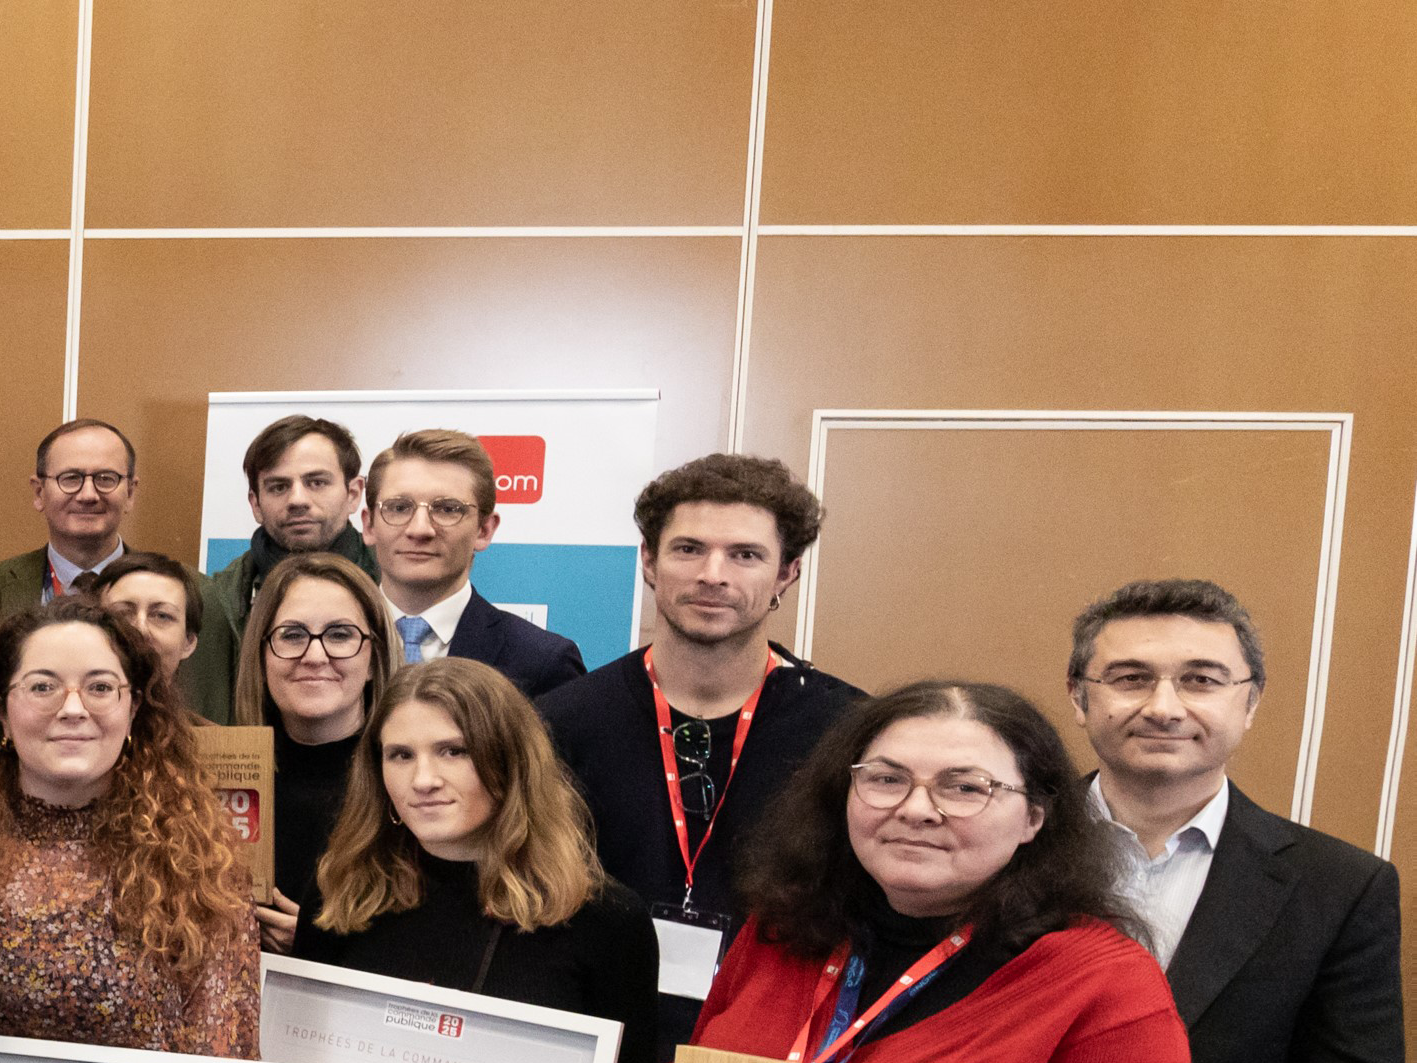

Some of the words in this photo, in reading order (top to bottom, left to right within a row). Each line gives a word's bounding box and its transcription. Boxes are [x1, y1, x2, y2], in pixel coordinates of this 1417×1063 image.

[495, 475, 537, 491] om
[218, 771, 260, 782] blique
[385, 1015, 436, 1031] publique
[443, 1016, 459, 1027] 20
[285, 1025, 351, 1049] TROPHÉES
[357, 1041, 374, 1054] DE
[381, 1046, 396, 1057] LA
